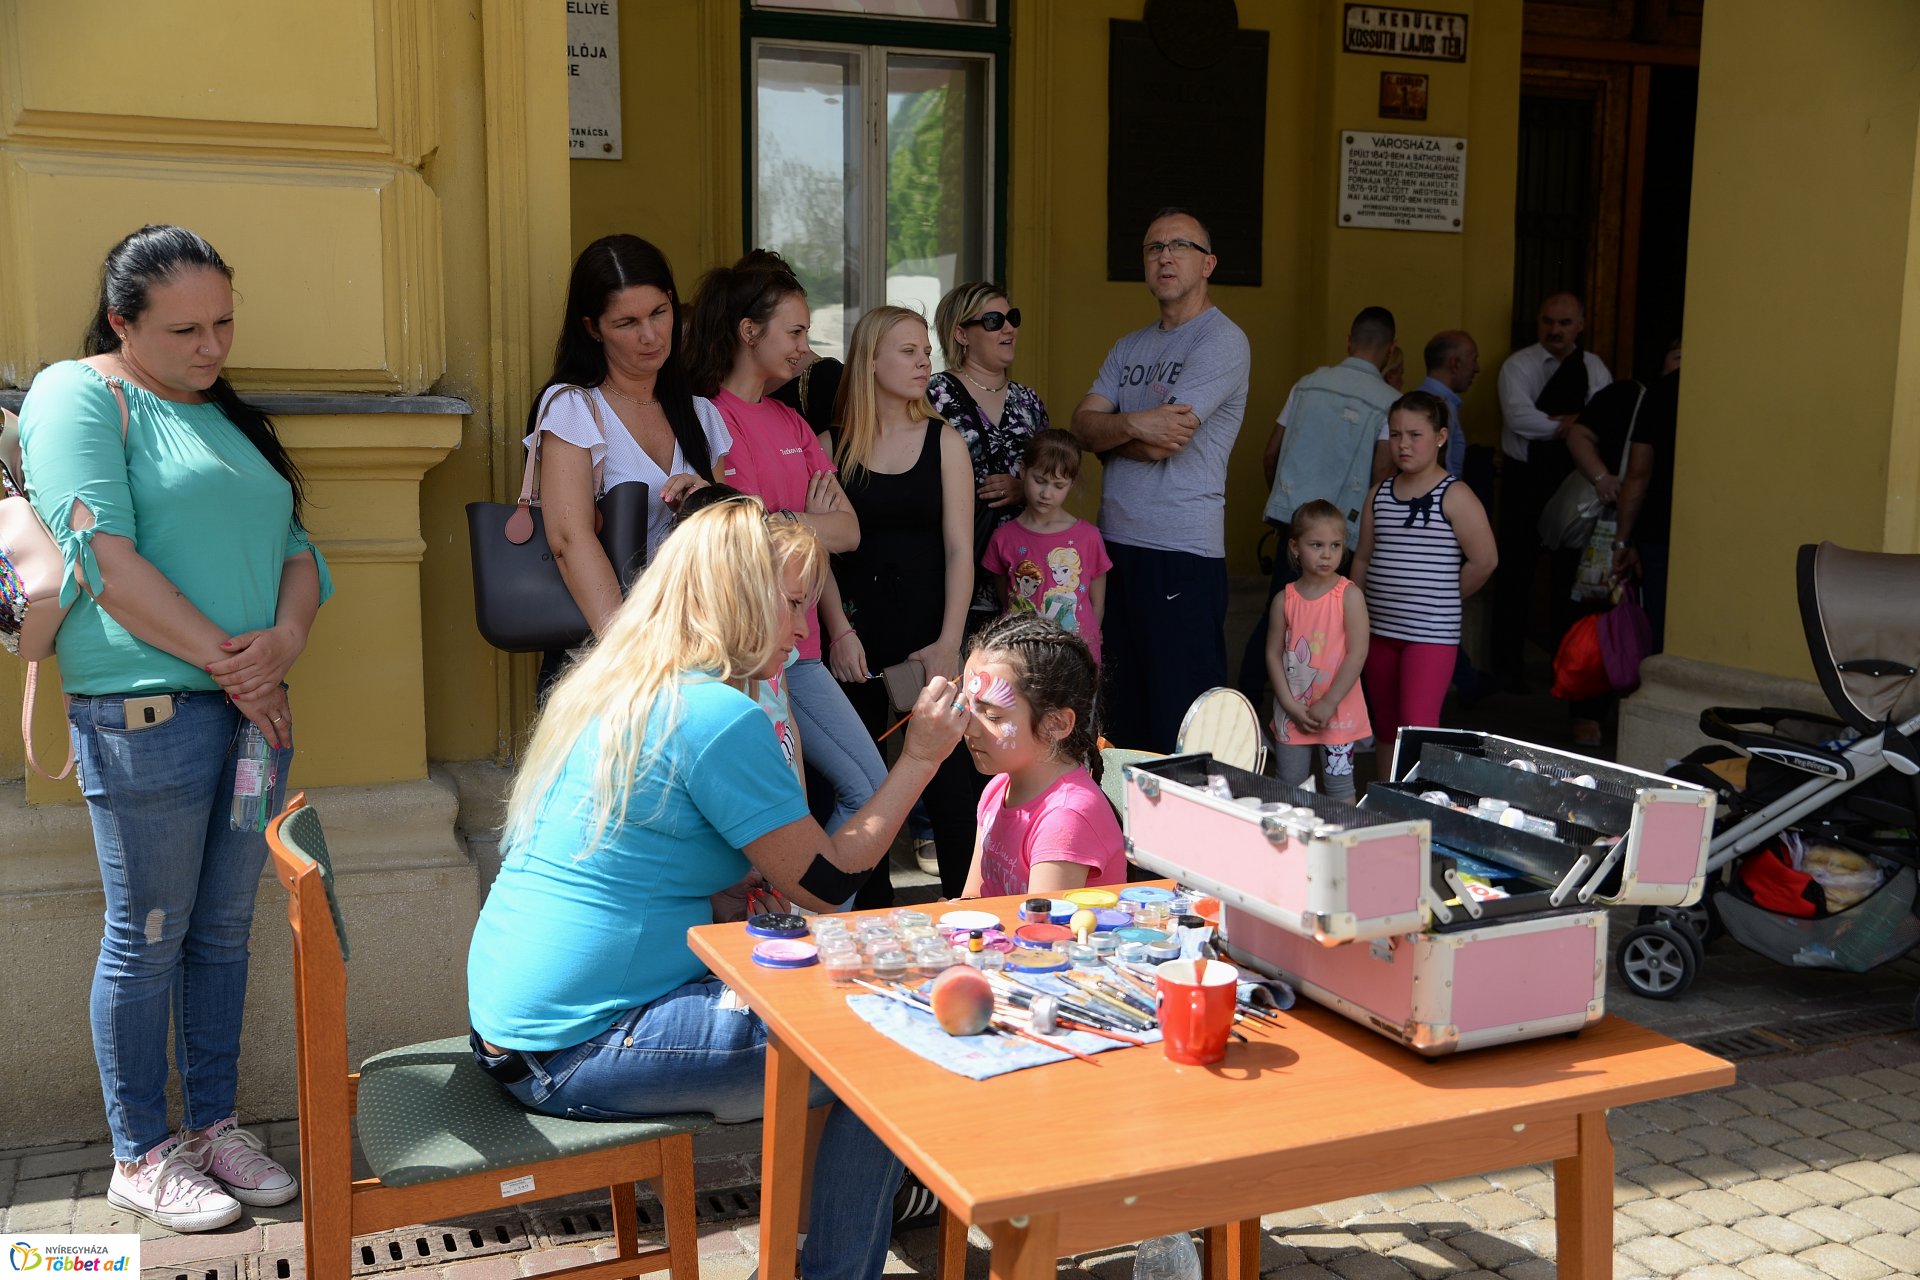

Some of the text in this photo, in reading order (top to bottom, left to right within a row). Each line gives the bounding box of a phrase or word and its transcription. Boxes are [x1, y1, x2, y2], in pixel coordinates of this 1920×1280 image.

[1361, 10, 1455, 32] I. KERÜLET
[1348, 28, 1461, 56] KOSSUTH LAJOS TÉR
[571, 127, 609, 137] TANÁCSA
[1372, 136, 1441, 151] VÁROSHÁZA
